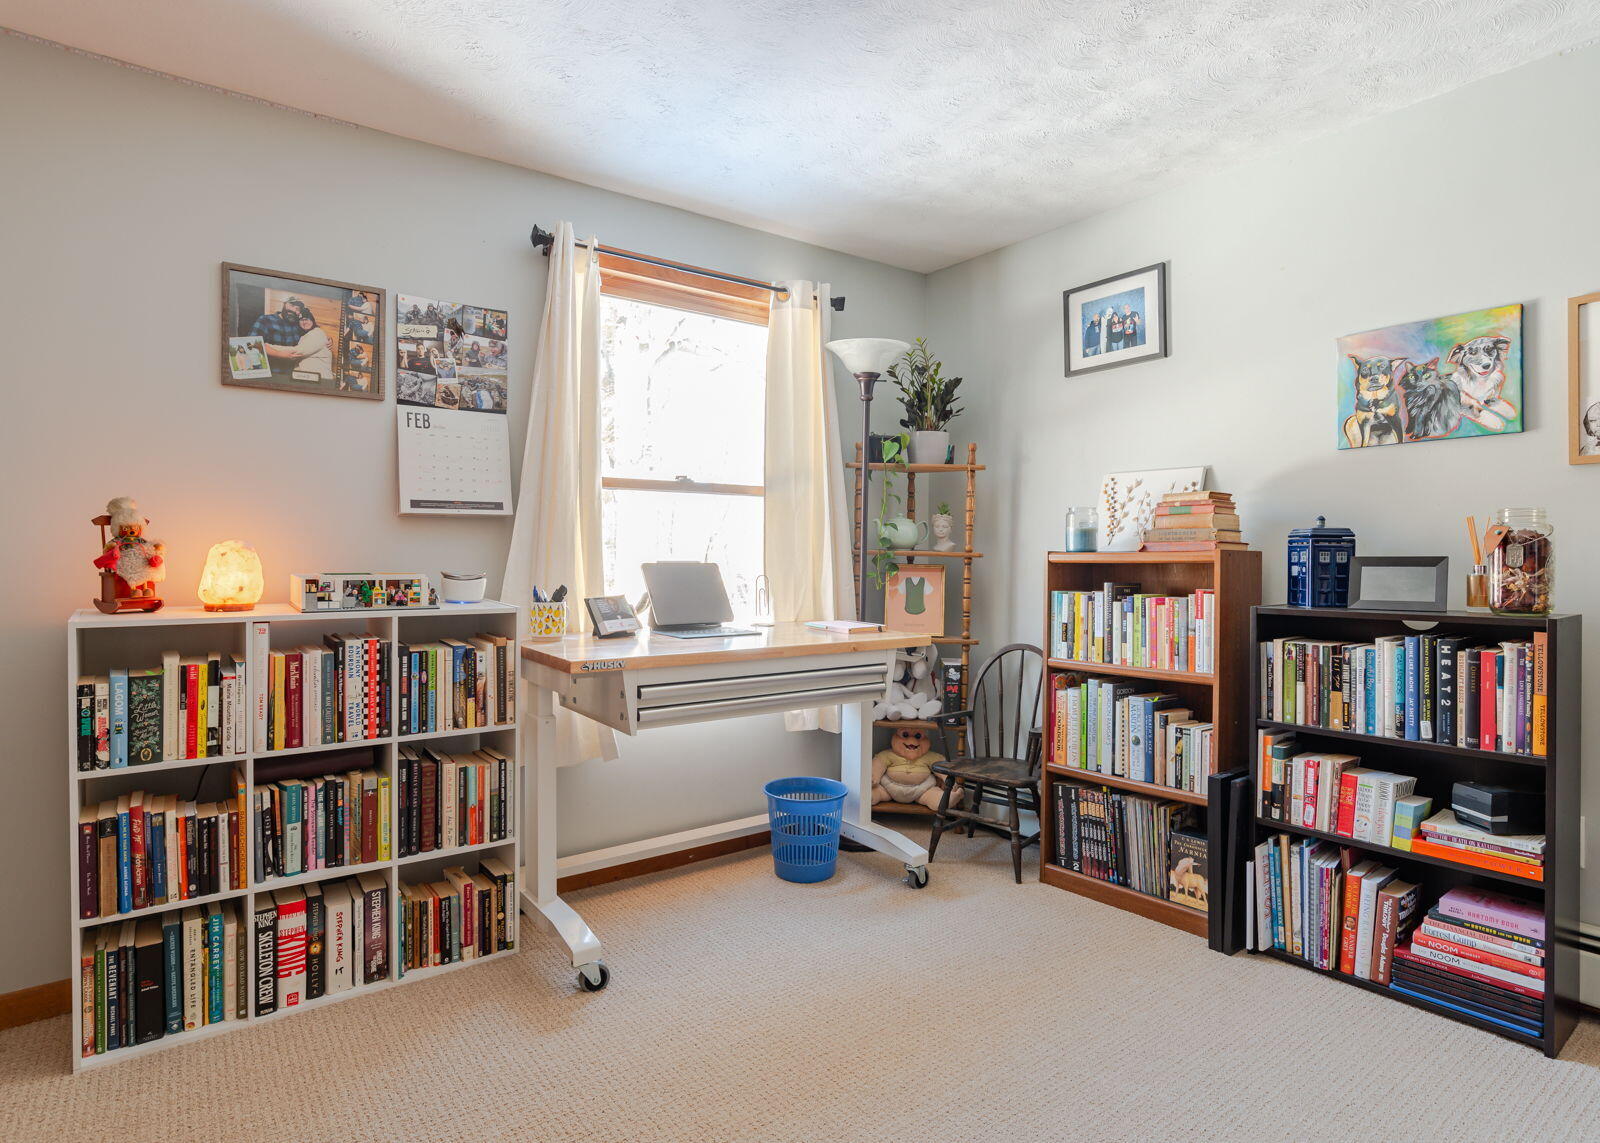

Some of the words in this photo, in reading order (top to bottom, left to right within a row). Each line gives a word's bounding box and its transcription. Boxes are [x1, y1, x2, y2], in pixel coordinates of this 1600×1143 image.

[406, 412, 431, 429] FEB
[592, 660, 625, 670] HUSKY
[1367, 652, 1375, 677] Beautiful
[1441, 645, 1451, 694] HEAT
[1366, 678, 1374, 690] Boy
[114, 682, 124, 715] LAGOM
[1441, 699, 1451, 707] 2
[131, 709, 160, 723] Women
[134, 702, 158, 714] Little
[1451, 836, 1468, 847] DEATH
[1178, 846, 1208, 859] NARNIA
[1073, 863, 1080, 871] 2
[254, 910, 278, 922] STEPHEN
[371, 891, 381, 923] STEPHEN
[1381, 900, 1389, 928] TRILOGY
[212, 917, 220, 933] JIM
[258, 919, 274, 929] KING
[336, 912, 344, 942] STEPHEN
[1467, 911, 1499, 924] ANATOMY
[1500, 918, 1519, 929] BOOK
[280, 925, 305, 937] STEPHEN
[371, 923, 381, 939] KING
[1423, 925, 1451, 940] Forrest
[1452, 935, 1478, 949] Gump
[1429, 920, 1440, 928] THE
[1442, 923, 1476, 937] FINANCIAL
[1478, 933, 1495, 943] DIET
[1471, 923, 1496, 935] BUTCHER
[1513, 933, 1531, 945] WREN
[212, 935, 220, 970] CARREY
[1381, 933, 1389, 954] Douglas
[1428, 940, 1459, 955] NOOM
[258, 930, 274, 976] SKELETON
[277, 932, 306, 979] KING
[336, 943, 344, 963] KING
[1429, 950, 1461, 966] NOOM
[1379, 954, 1387, 973] Adams
[108, 965, 117, 1001] REVENANT
[258, 977, 274, 1005] CREW
